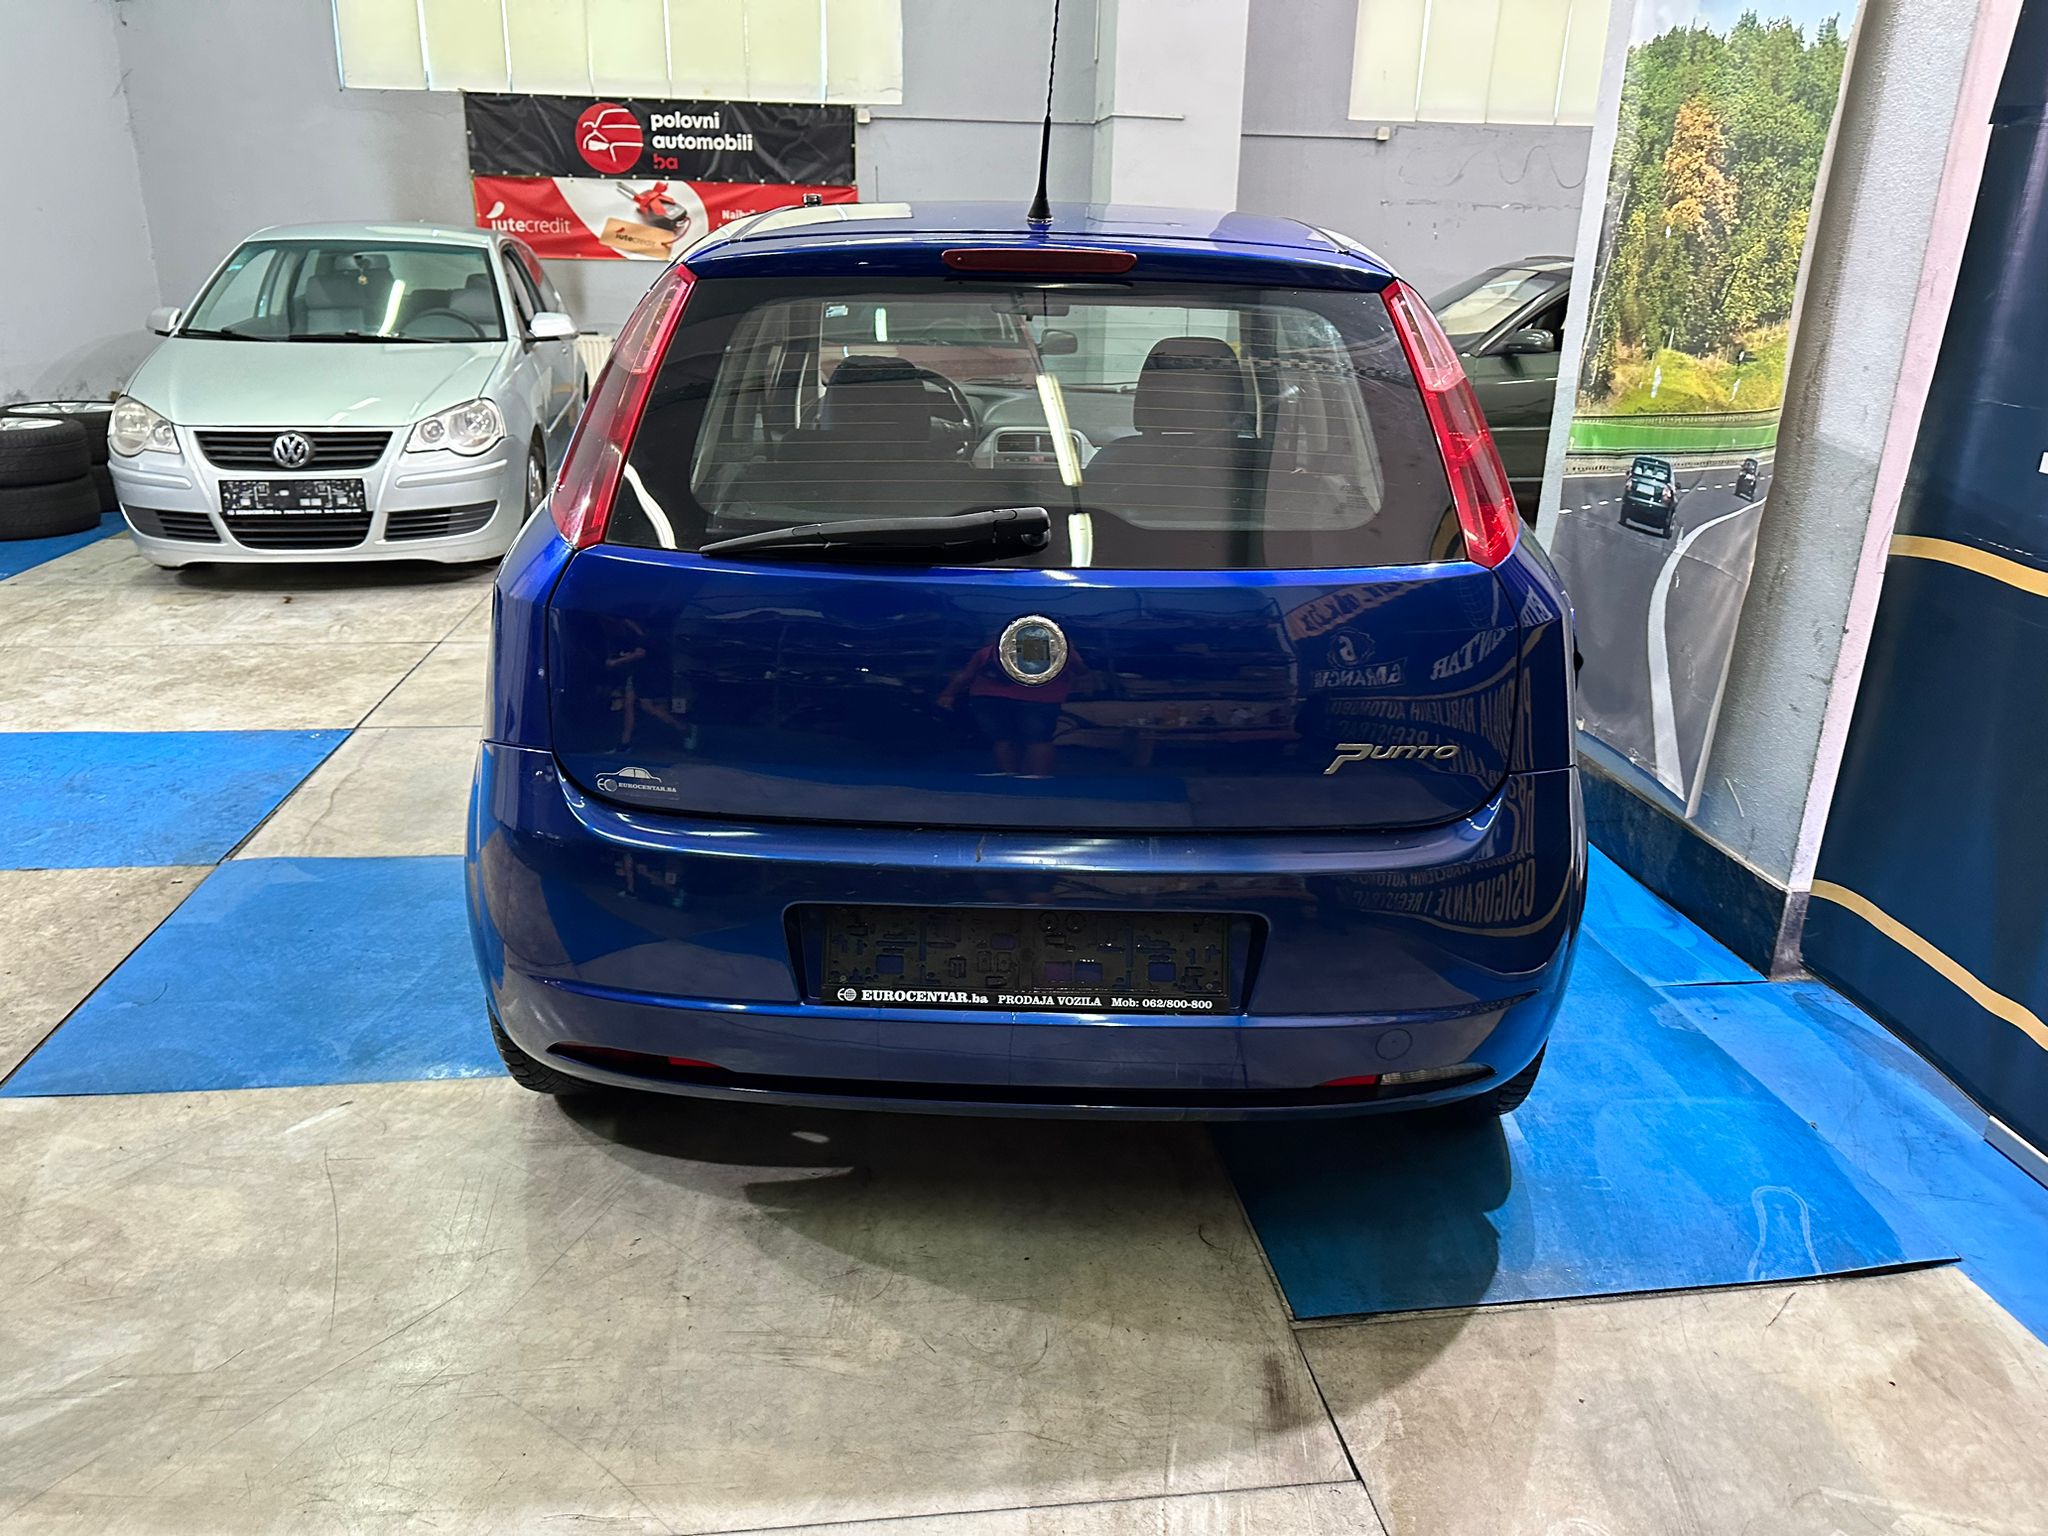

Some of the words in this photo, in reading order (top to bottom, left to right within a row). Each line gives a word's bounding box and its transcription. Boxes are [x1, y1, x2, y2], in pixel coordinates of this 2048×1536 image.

[650, 111, 720, 131] polovni
[652, 133, 753, 151] automobili
[861, 989, 989, 1004] EUROCENTAR.ba
[997, 994, 1055, 1006] PRODAJA
[1057, 996, 1102, 1007] VOZILA
[1110, 997, 1140, 1008] Mob:
[1142, 999, 1213, 1009] 062/800-800
